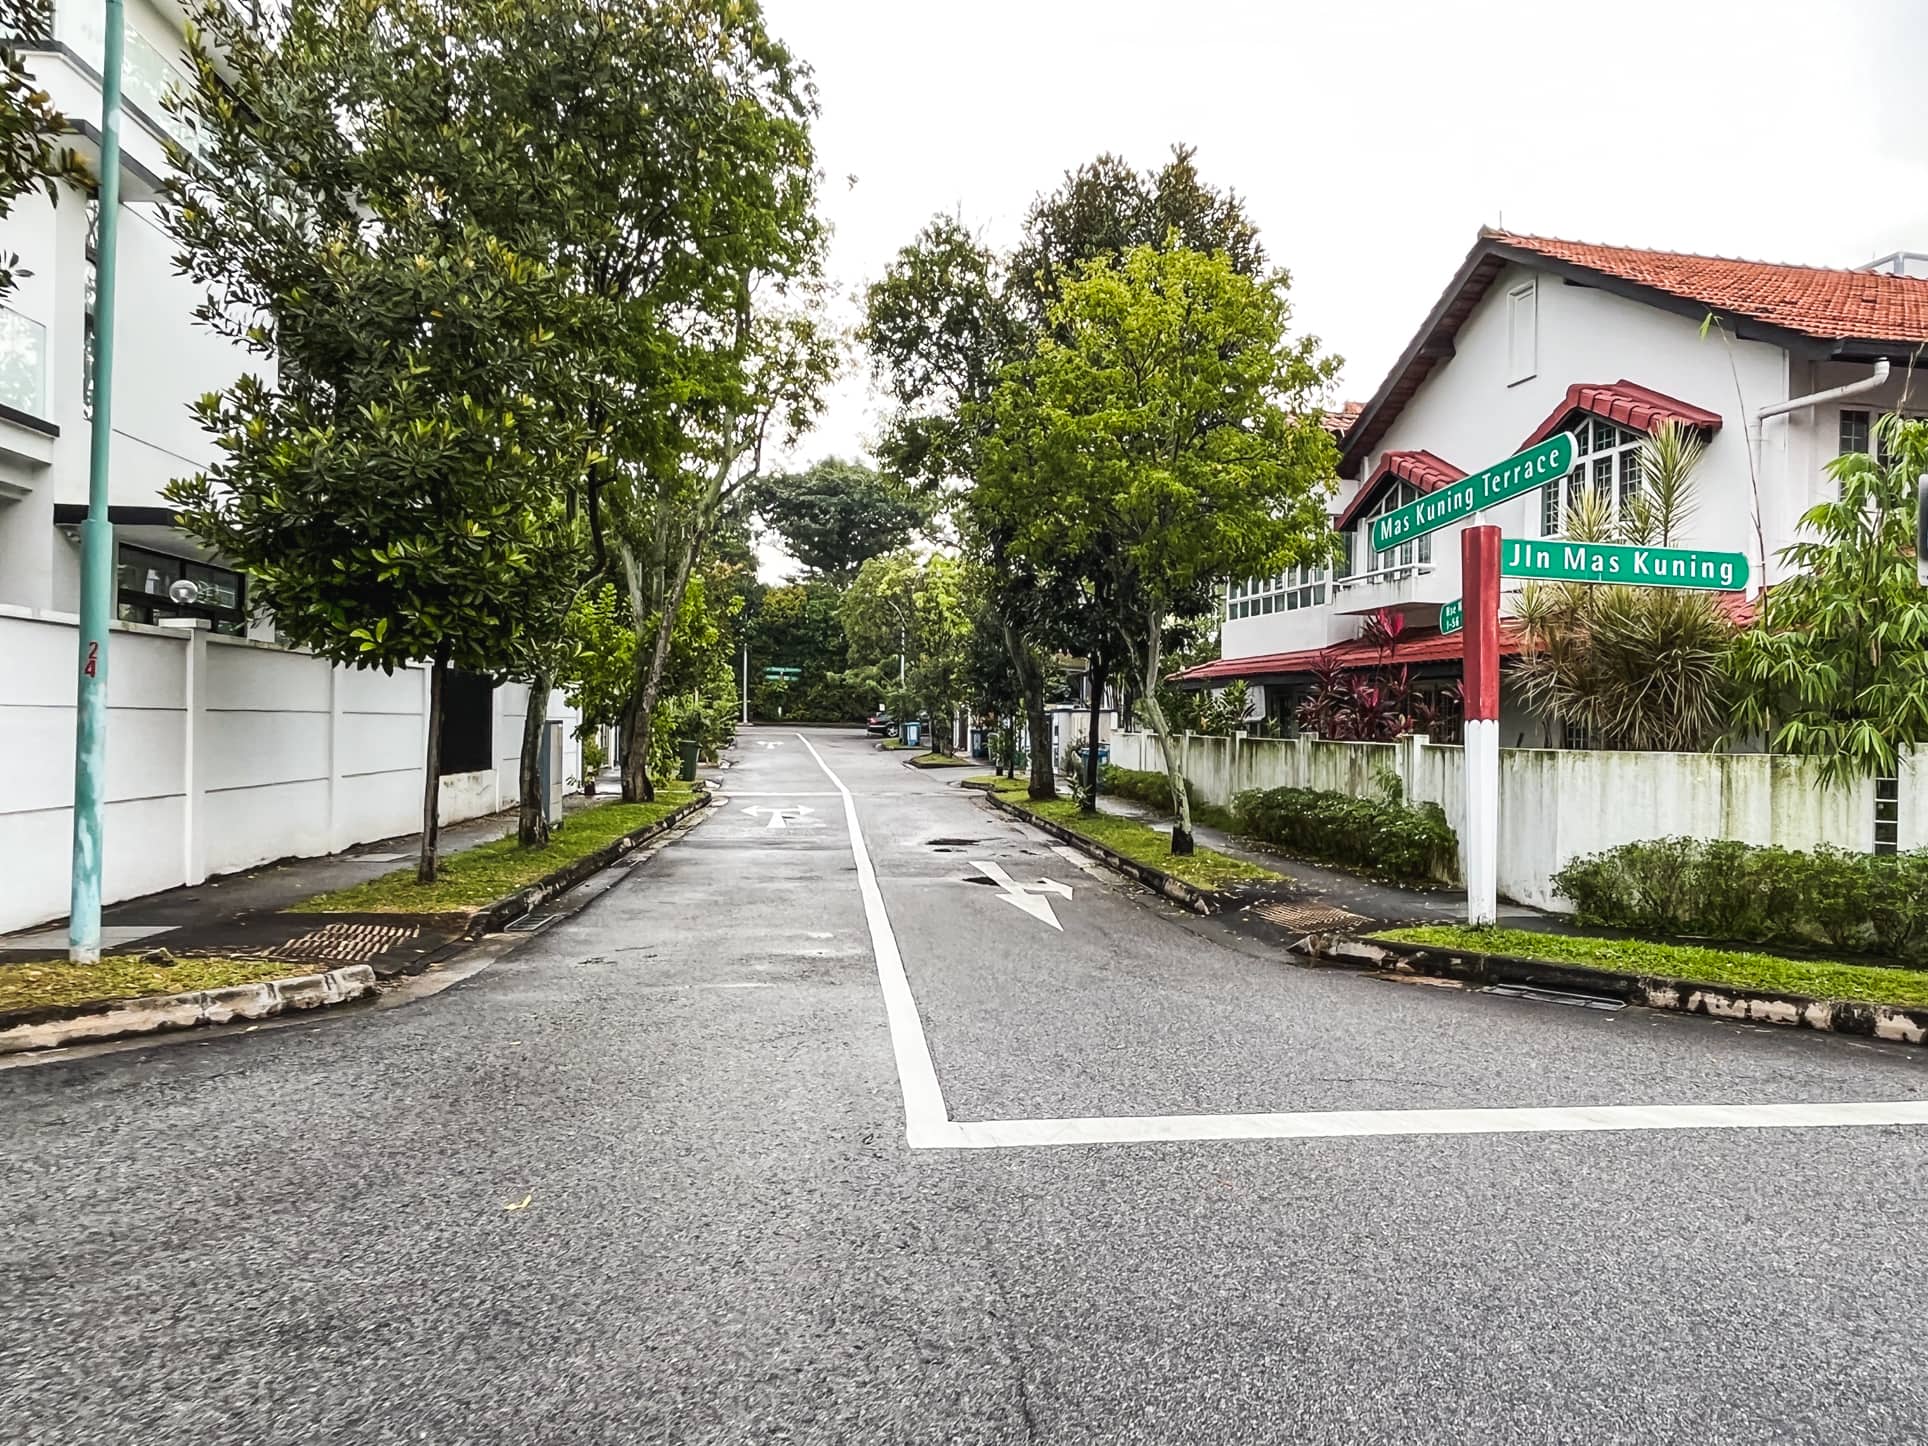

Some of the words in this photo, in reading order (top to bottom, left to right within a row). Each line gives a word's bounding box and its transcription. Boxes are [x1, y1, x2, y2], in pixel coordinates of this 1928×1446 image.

[1380, 514, 1410, 541] Mas
[1415, 487, 1474, 526] Kuning
[1482, 447, 1560, 498] Terrace
[1509, 543, 1550, 568] Jln
[1564, 546, 1621, 573] Mas
[1634, 551, 1734, 586] Kuning
